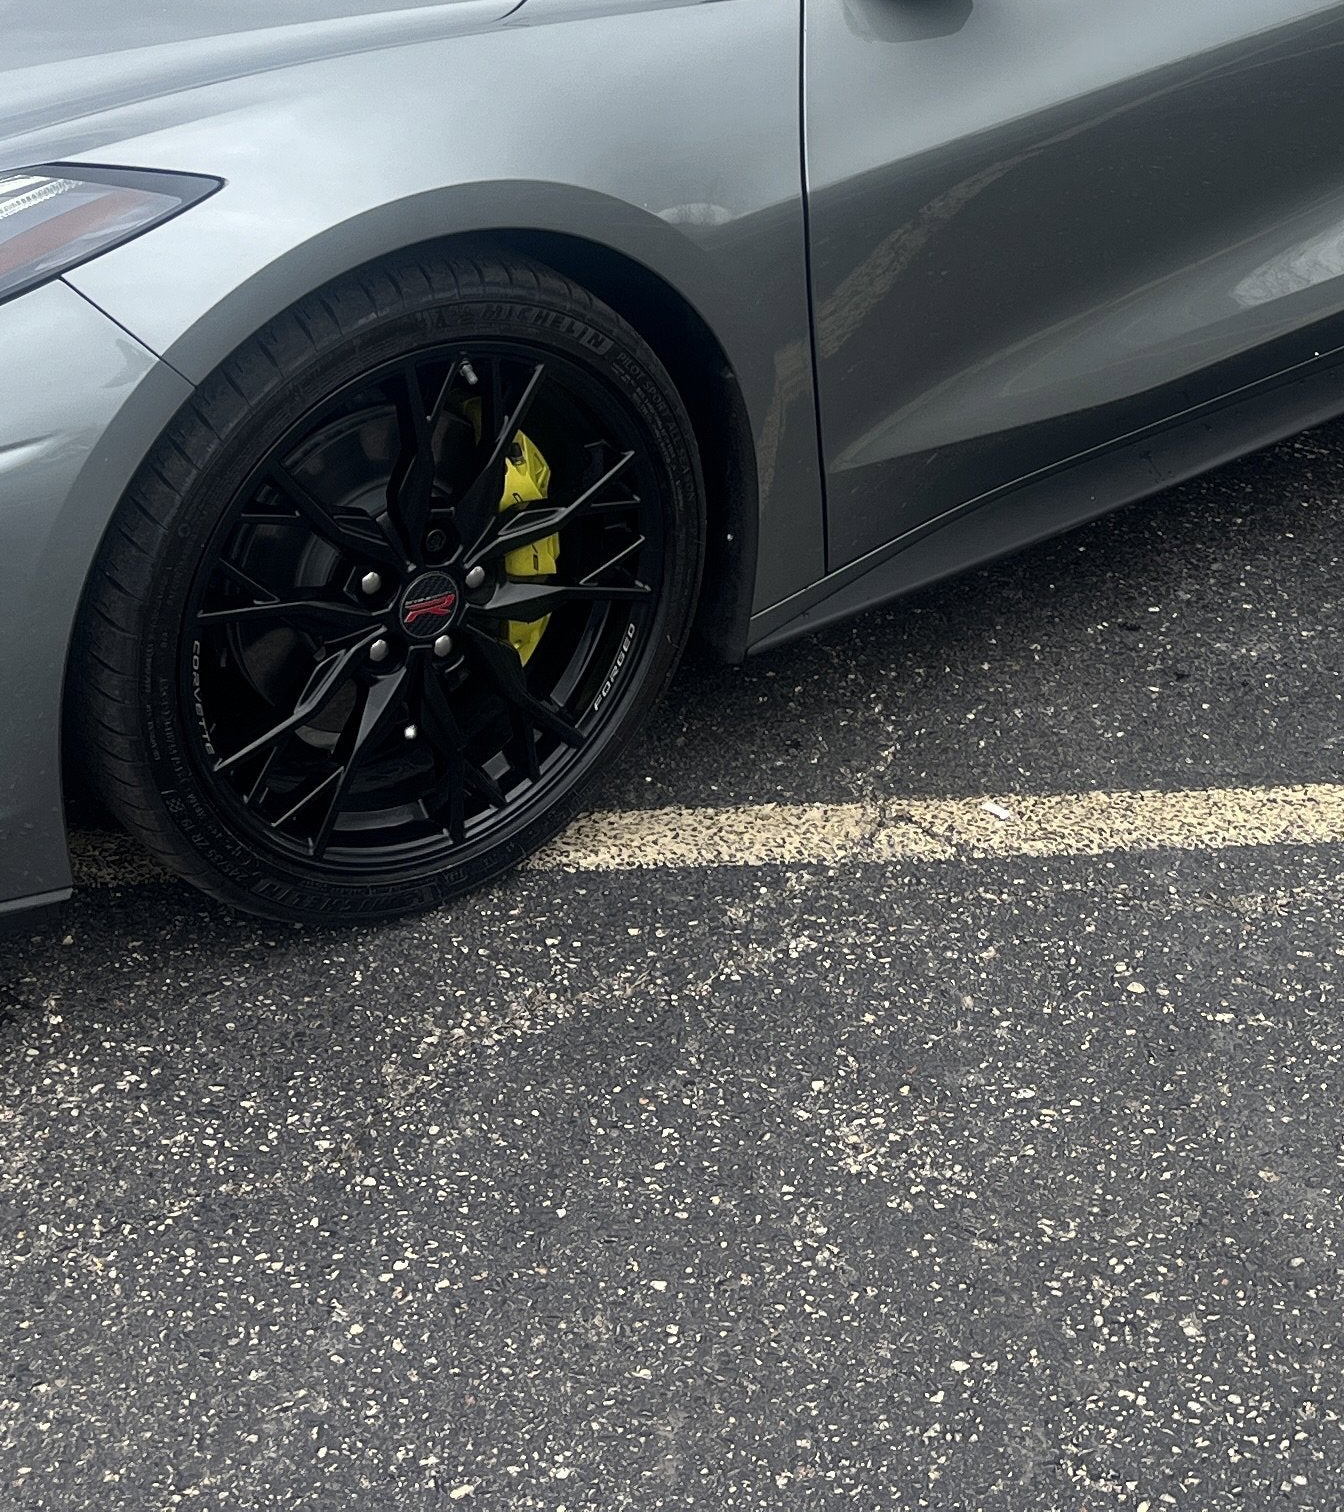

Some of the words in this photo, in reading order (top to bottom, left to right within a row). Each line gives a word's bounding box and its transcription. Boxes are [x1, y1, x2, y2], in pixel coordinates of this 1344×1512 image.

[480, 304, 608, 354] MICHELIN
[615, 351, 646, 381] PILOT
[641, 380, 671, 418] SPORT
[191, 639, 216, 756] CORVETTE
[593, 623, 636, 711] FORGED
